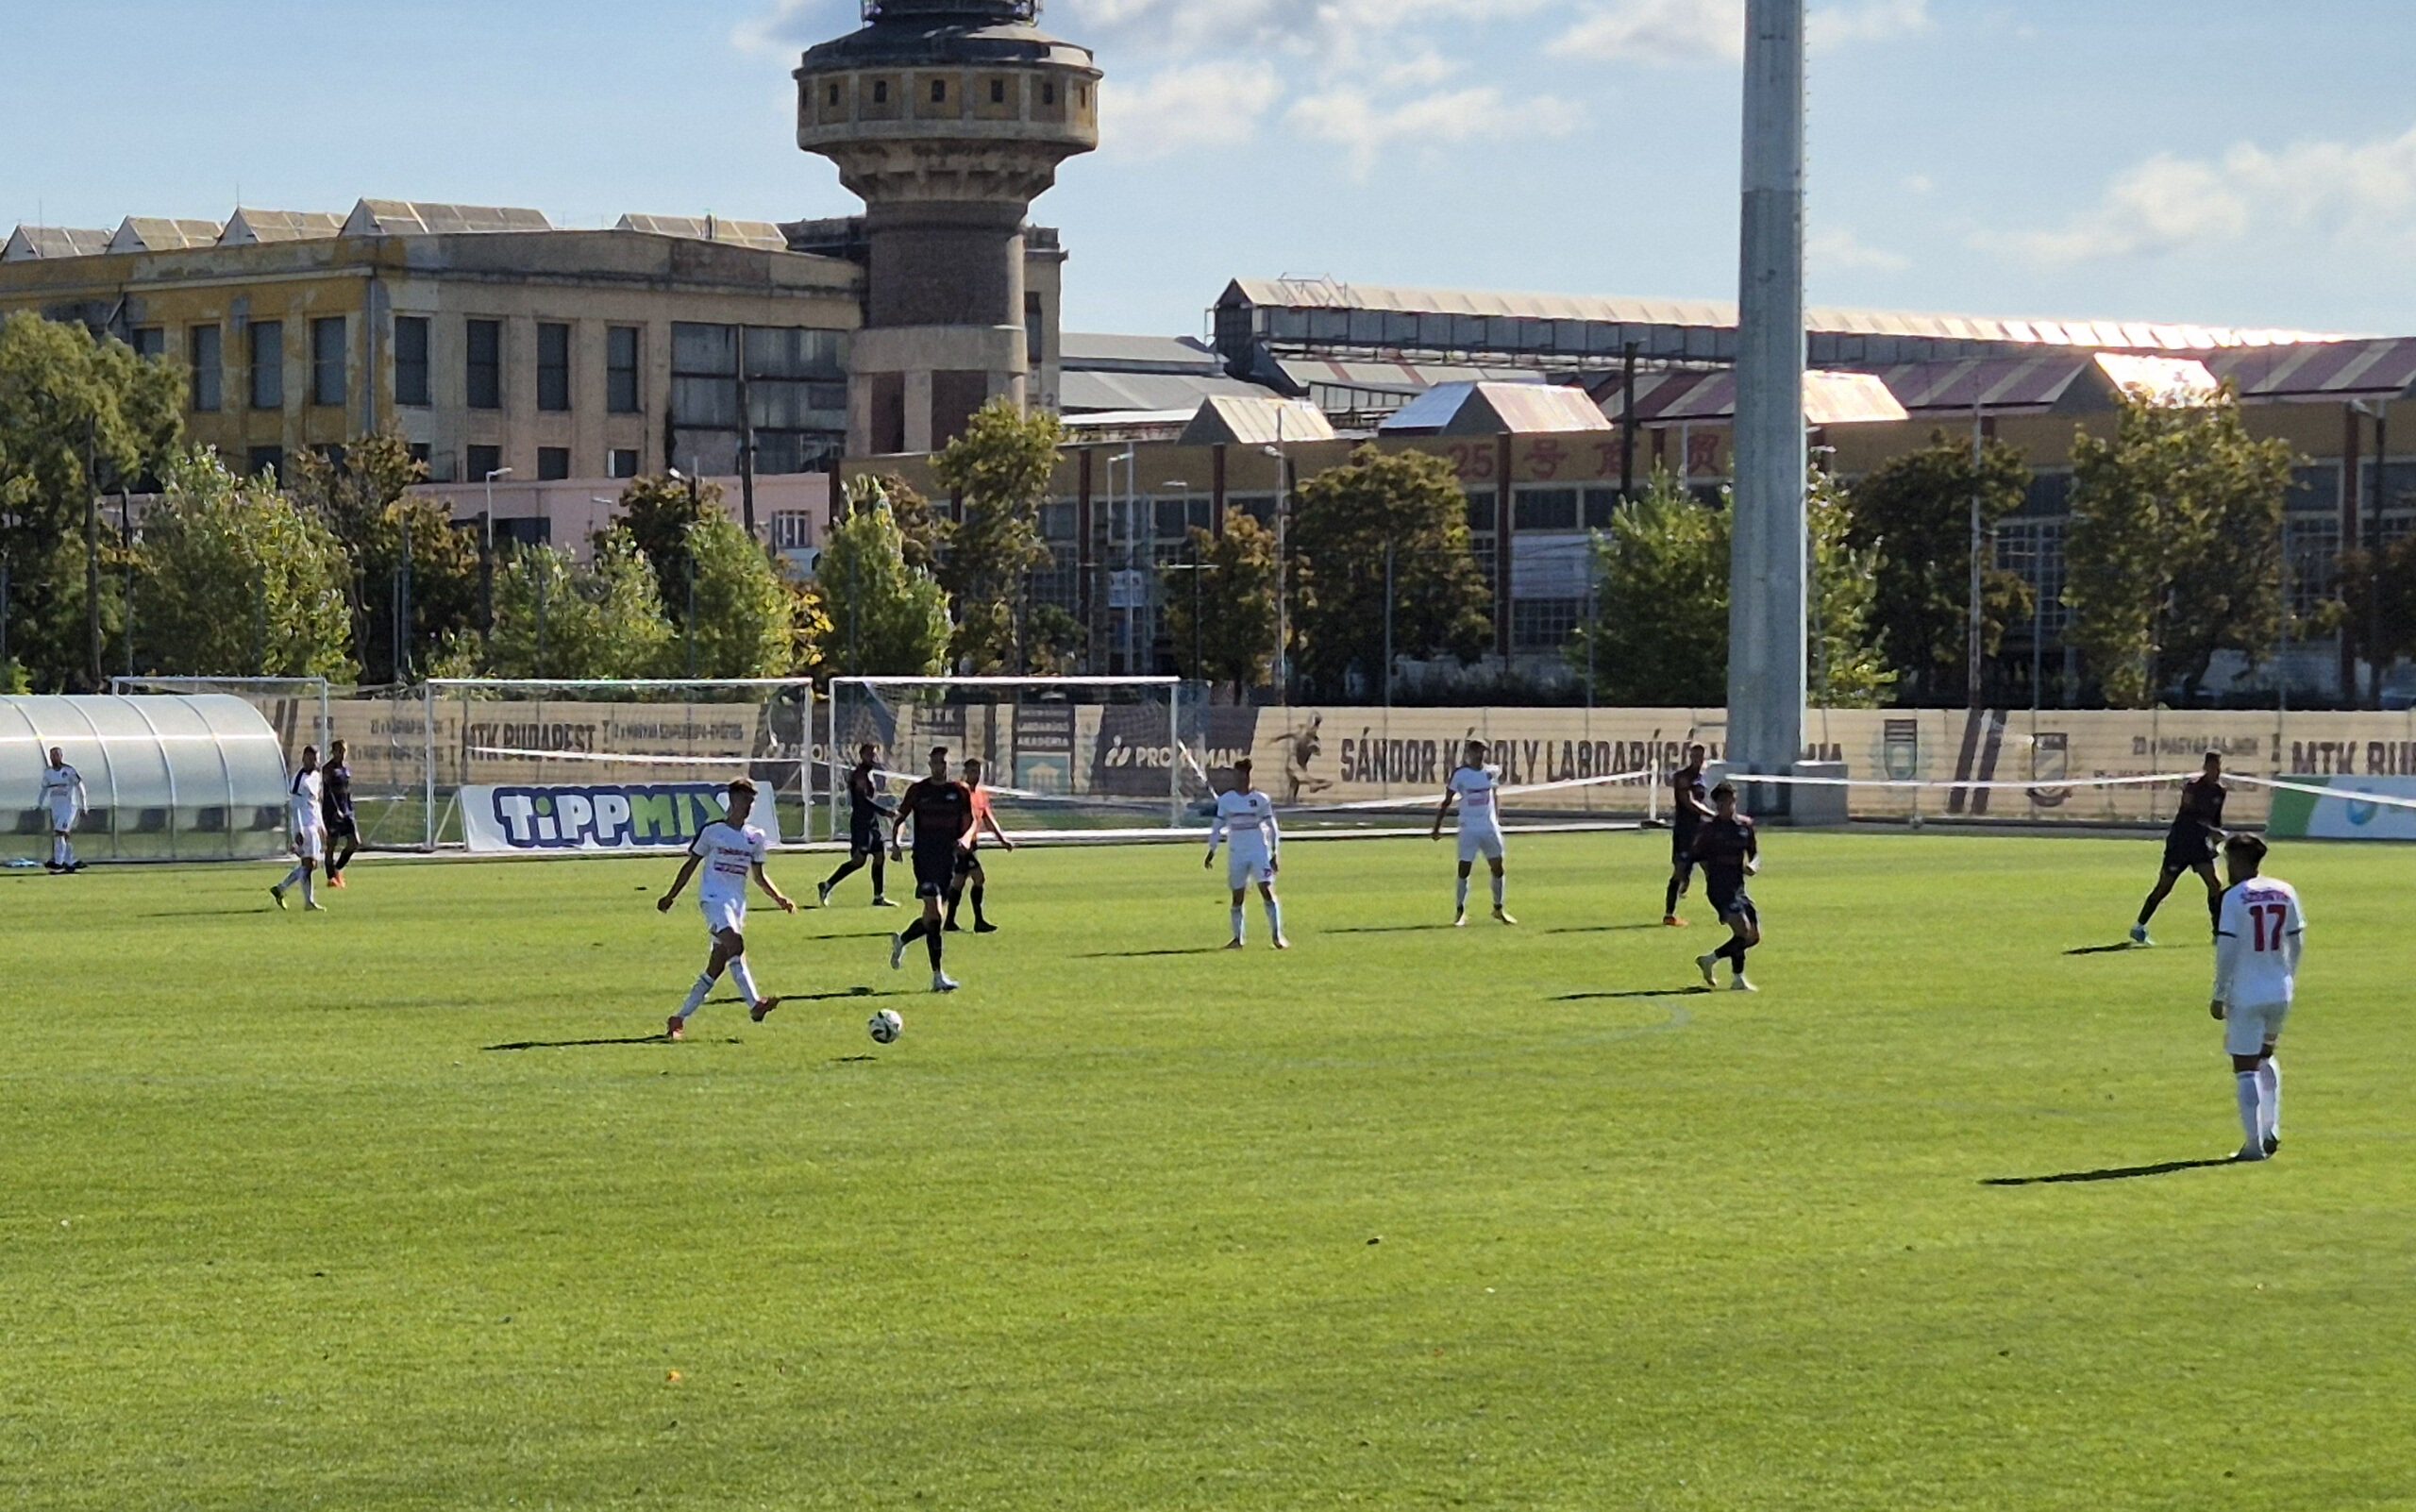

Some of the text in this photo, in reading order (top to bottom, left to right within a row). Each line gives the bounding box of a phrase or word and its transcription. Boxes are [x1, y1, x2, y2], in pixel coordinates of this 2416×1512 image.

[503, 723, 596, 762] BUDAPEST
[1341, 726, 1437, 784] SÁNDOR
[1443, 726, 1541, 785] KOLY
[2249, 903, 2287, 952] 17
